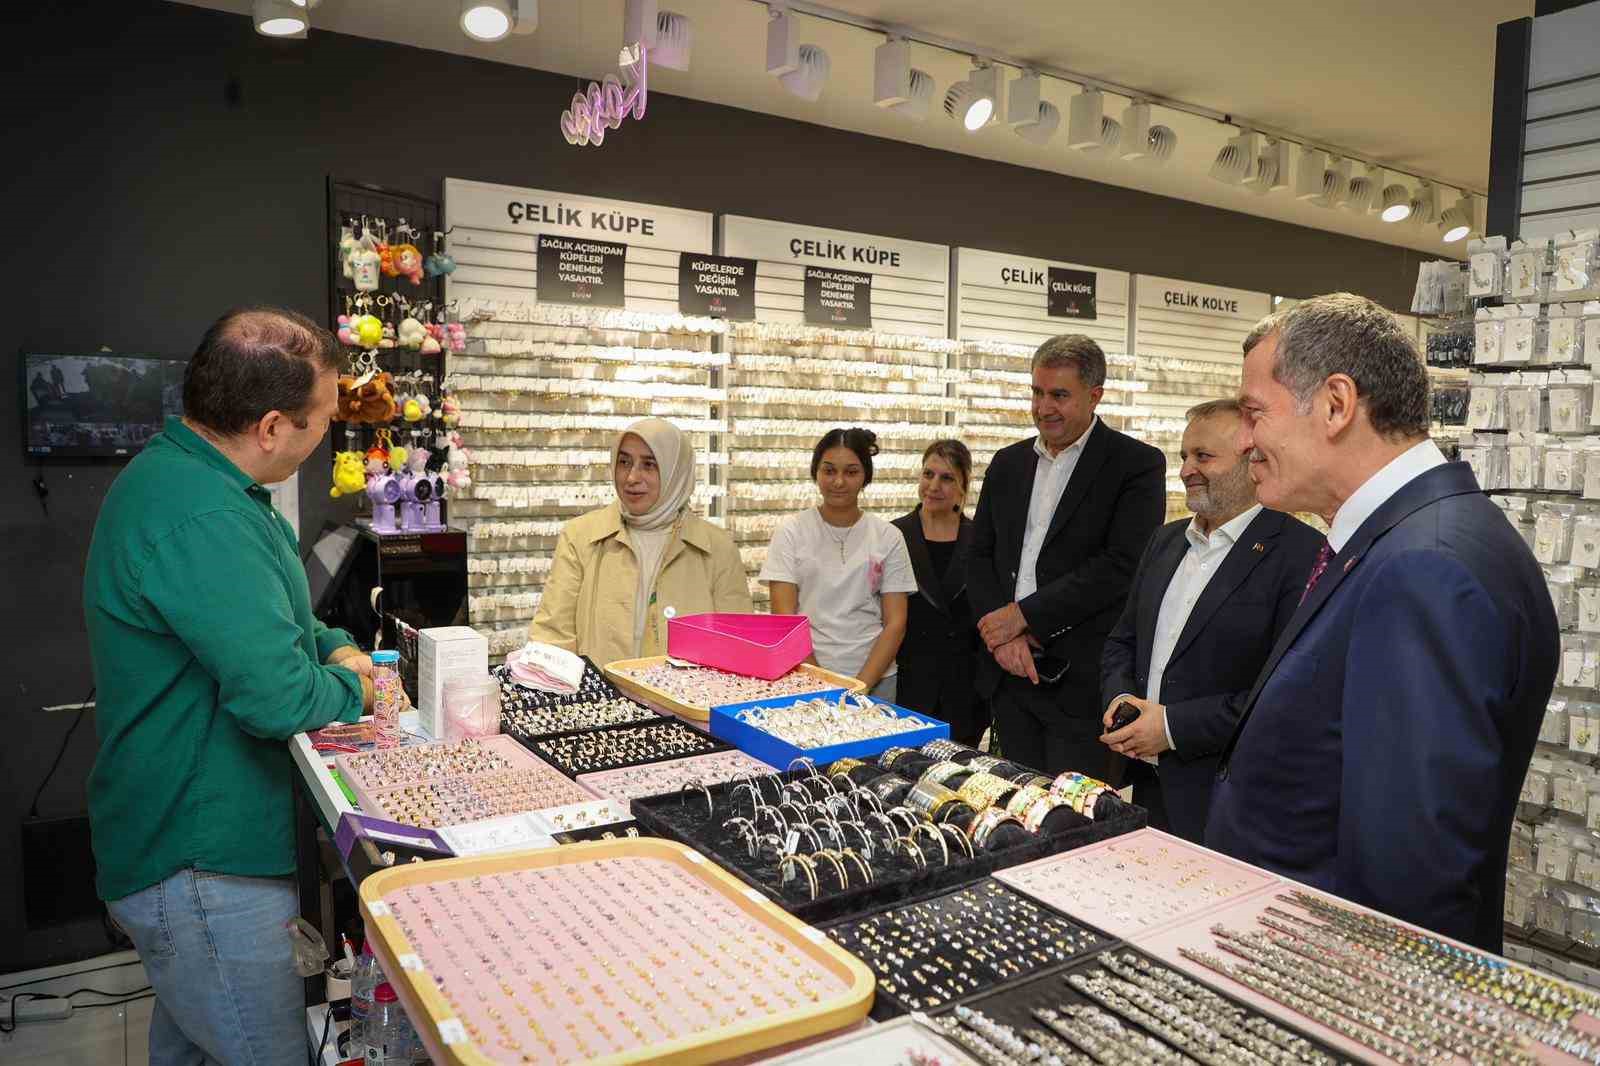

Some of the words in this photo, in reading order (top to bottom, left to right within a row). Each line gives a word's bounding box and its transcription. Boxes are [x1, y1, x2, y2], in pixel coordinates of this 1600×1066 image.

[507, 200, 582, 228] ÇELİK
[591, 211, 655, 237] KÜPE
[541, 239, 574, 251] SAĞLIK
[574, 243, 624, 256] AÇISINDAN
[790, 238, 846, 260] ÇELİK
[852, 246, 901, 267] KÜPE
[560, 251, 604, 265] KÜPELERİ
[559, 262, 604, 274] DENEMEK
[691, 261, 745, 275] KÜPELERDE
[558, 273, 604, 285] YASAKTIR.
[698, 273, 736, 286] DEĞİŞİM
[1001, 267, 1045, 286] ÇELİK
[694, 284, 740, 297] YASAKTIR.
[1164, 290, 1198, 308] ÇELİK
[1202, 297, 1238, 313] KOLYE
